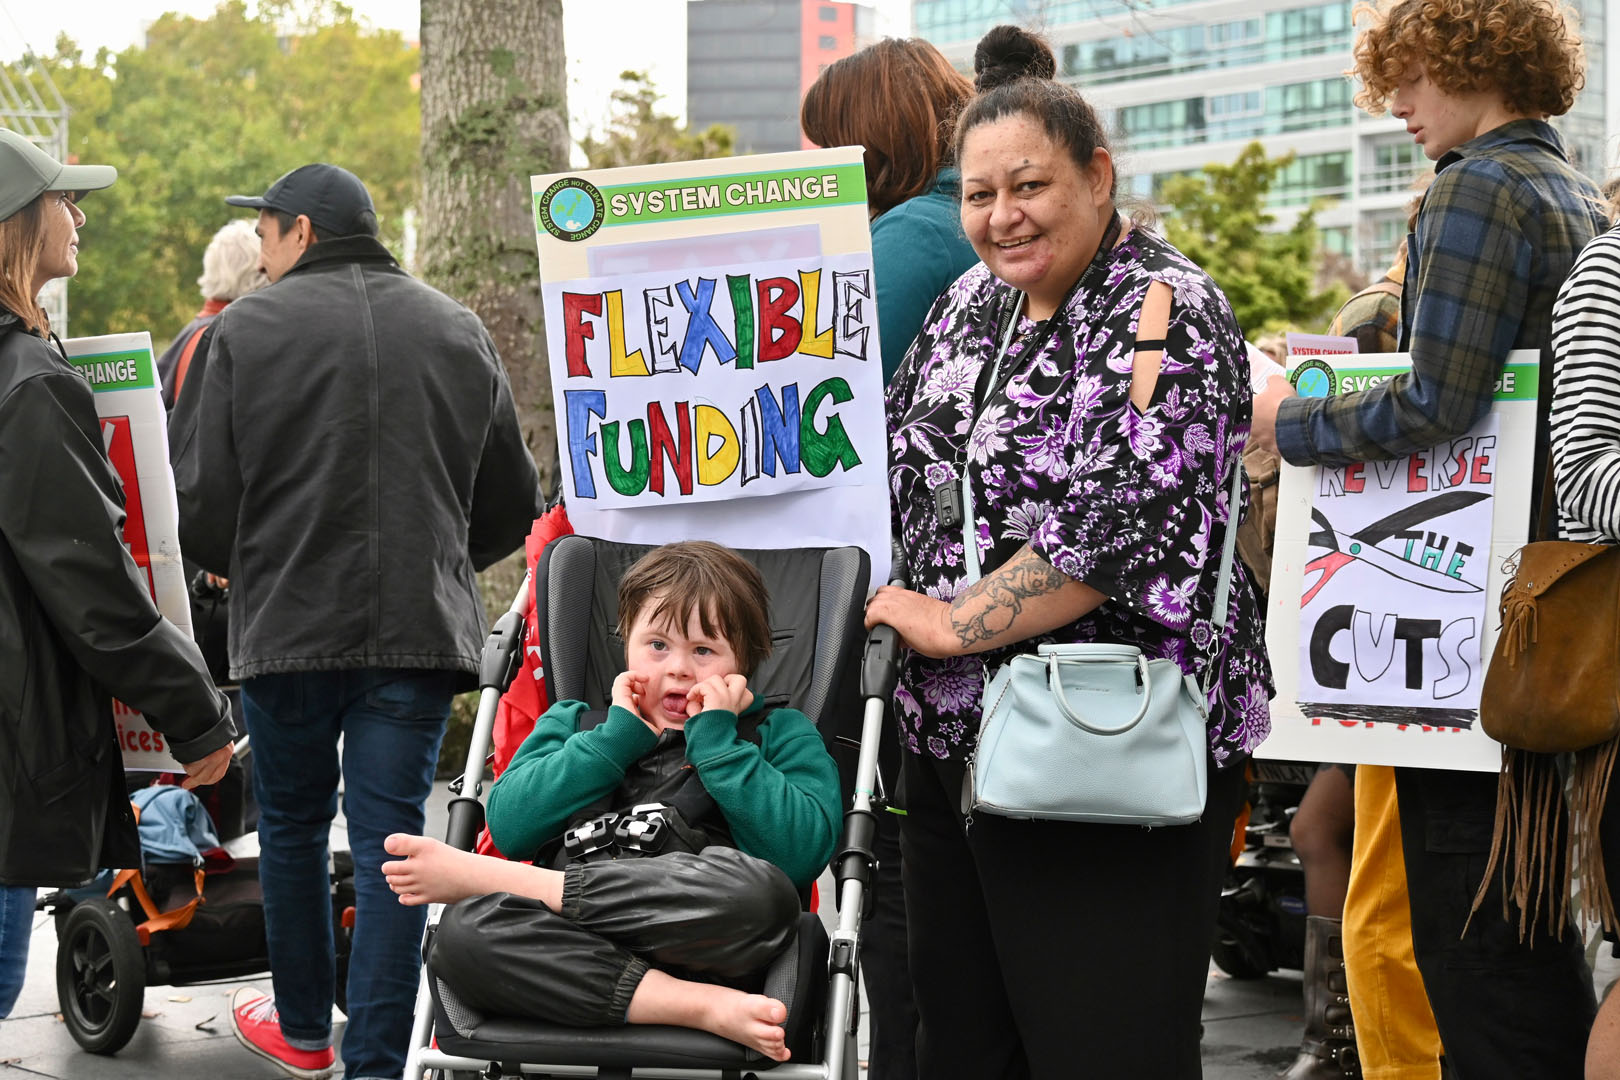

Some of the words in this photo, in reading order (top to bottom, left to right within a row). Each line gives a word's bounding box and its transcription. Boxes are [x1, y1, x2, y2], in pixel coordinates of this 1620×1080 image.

[542, 180, 569, 204] CHANGE
[571, 180, 584, 188] NOT
[585, 184, 605, 219] CLIMATE
[611, 185, 721, 217] SYSTEM
[725, 174, 839, 206] CHANGE
[541, 206, 560, 236] SYSTEM
[570, 219, 601, 241] CHANGE
[562, 268, 870, 378] FLEXIBLE
[1292, 347, 1321, 355] SYSTEM
[563, 377, 863, 499] FUNDING
[1320, 436, 1496, 497] REVERSE
[1394, 530, 1474, 580] THE
[1309, 604, 1475, 699] CUTS
